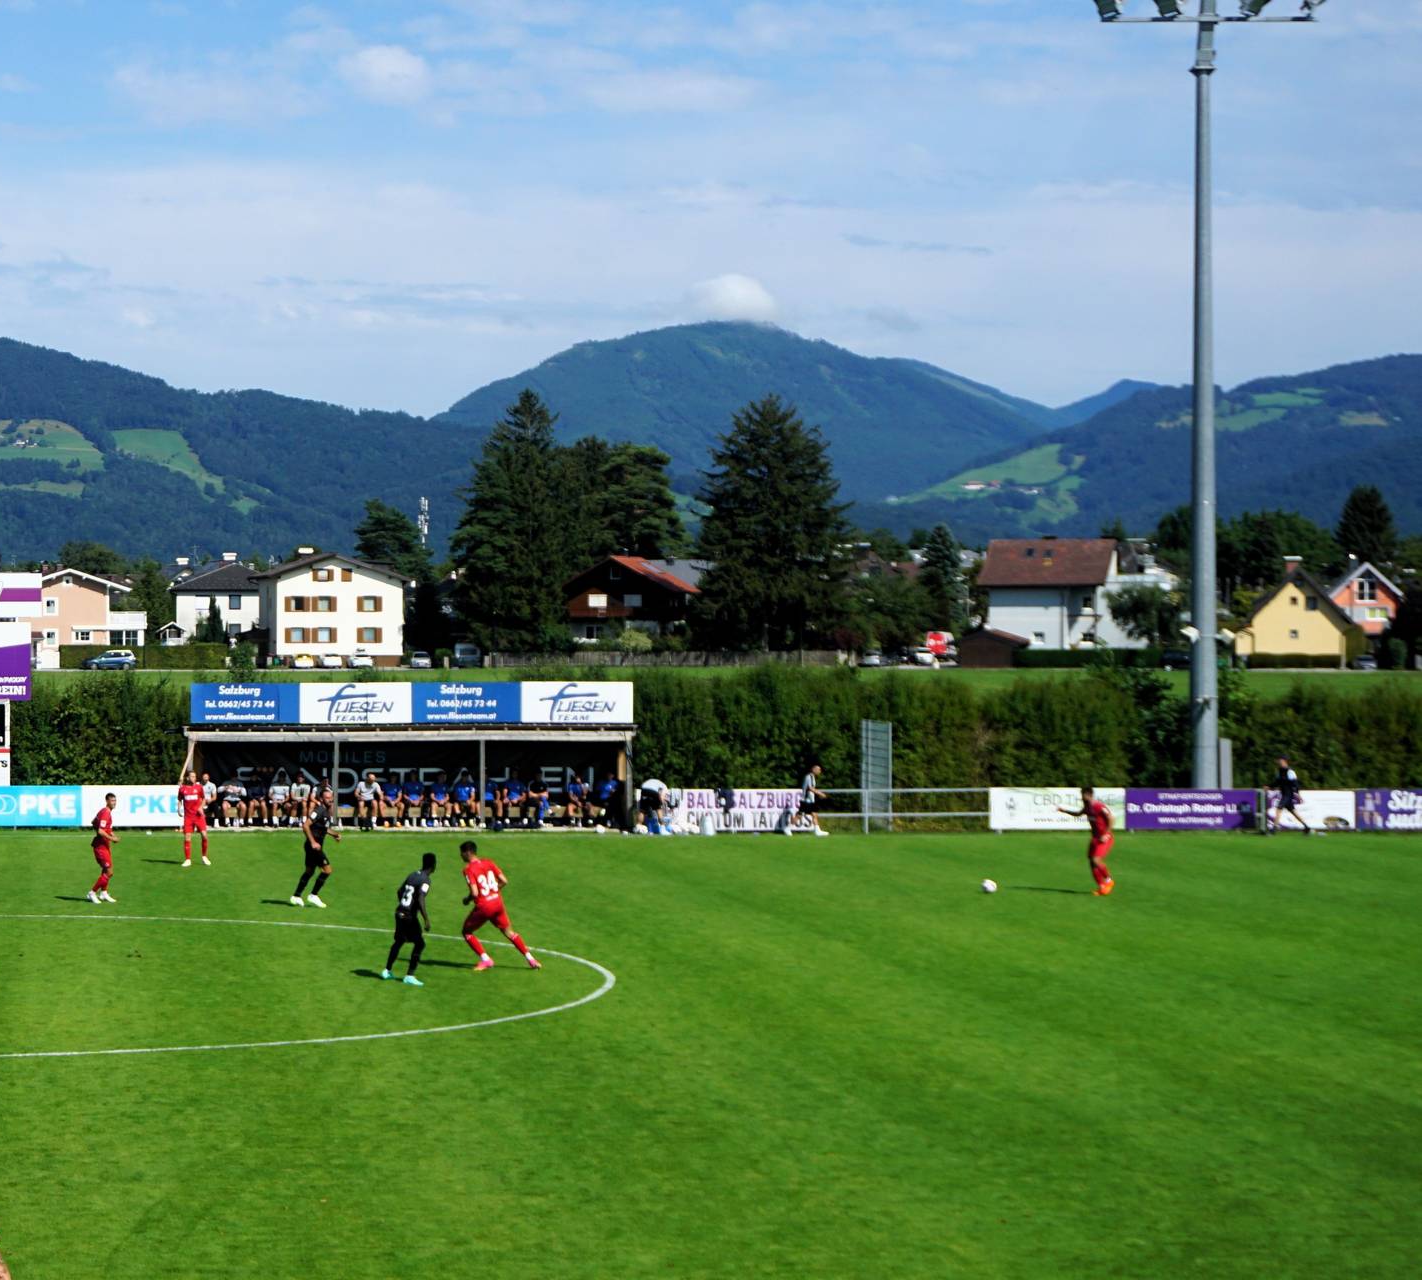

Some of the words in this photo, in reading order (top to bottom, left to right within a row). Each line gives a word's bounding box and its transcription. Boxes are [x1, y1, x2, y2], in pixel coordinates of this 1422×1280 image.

[218, 685, 261, 696] Salzburg
[440, 684, 482, 696] Salzburg
[299, 750, 386, 764] MOILES
[18, 794, 77, 815] PKE
[738, 791, 803, 809] ALZBURG
[478, 870, 498, 896] 34
